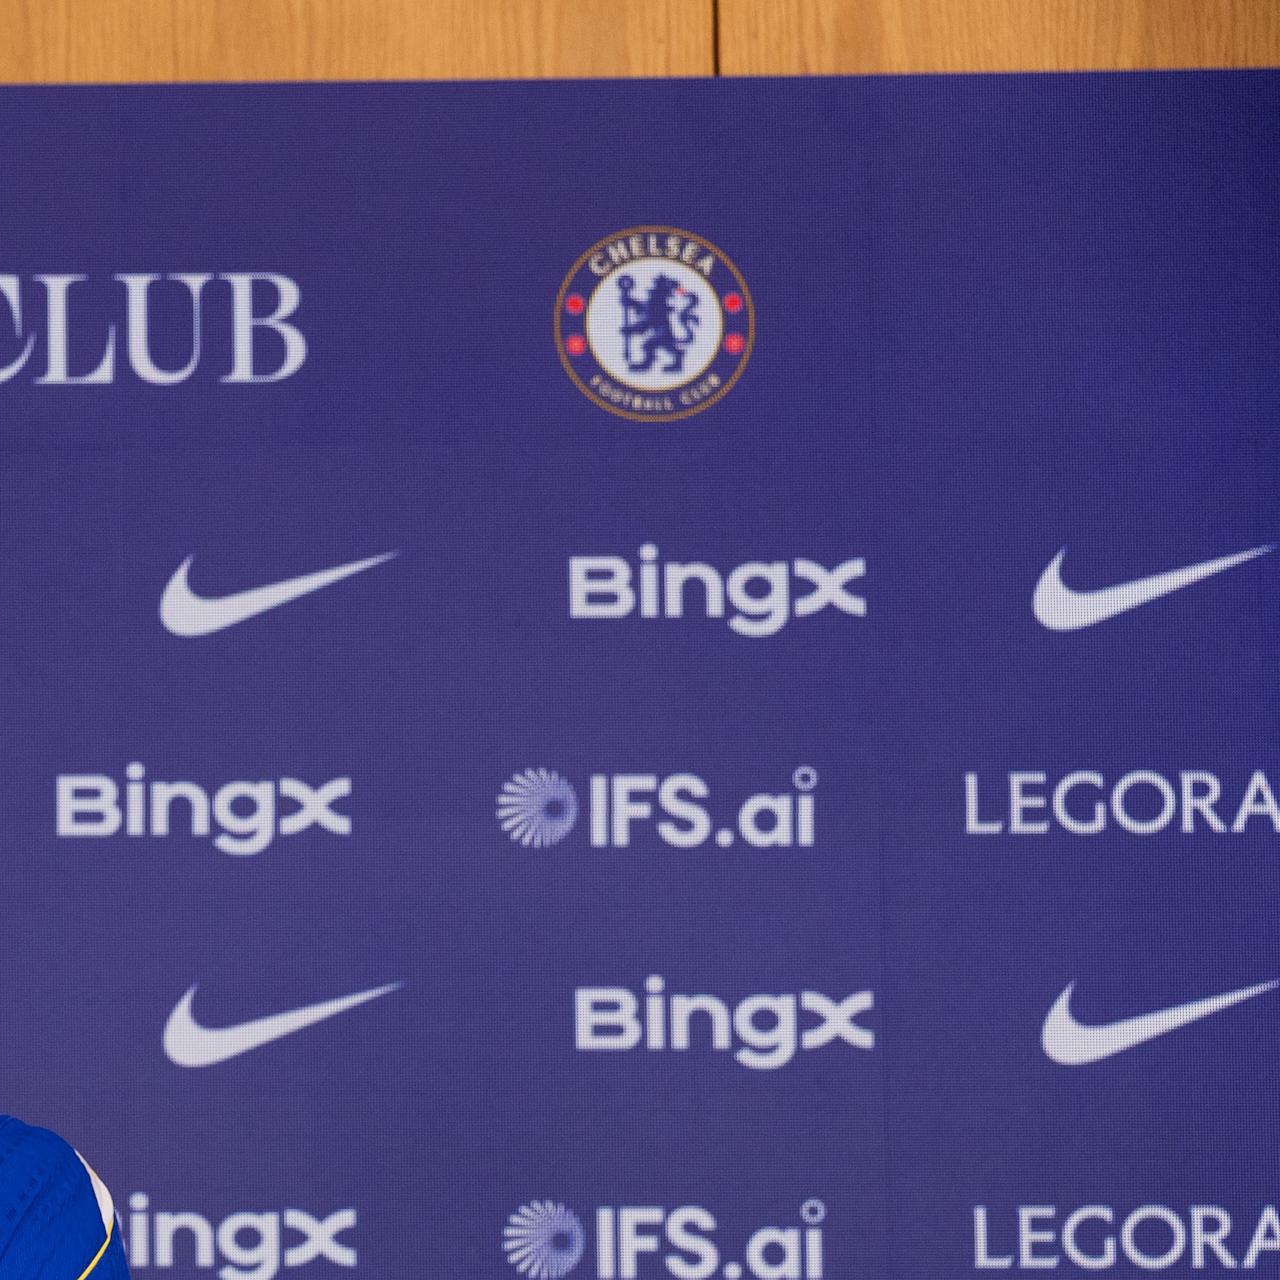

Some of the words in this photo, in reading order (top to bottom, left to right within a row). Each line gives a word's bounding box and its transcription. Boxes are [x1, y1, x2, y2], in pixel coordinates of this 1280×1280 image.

[589, 233, 716, 277] CHELSEA
[589, 766, 818, 849] IFS.ai
[964, 769, 1280, 836] LEGORA
[972, 1204, 1280, 1271] LEGORA
